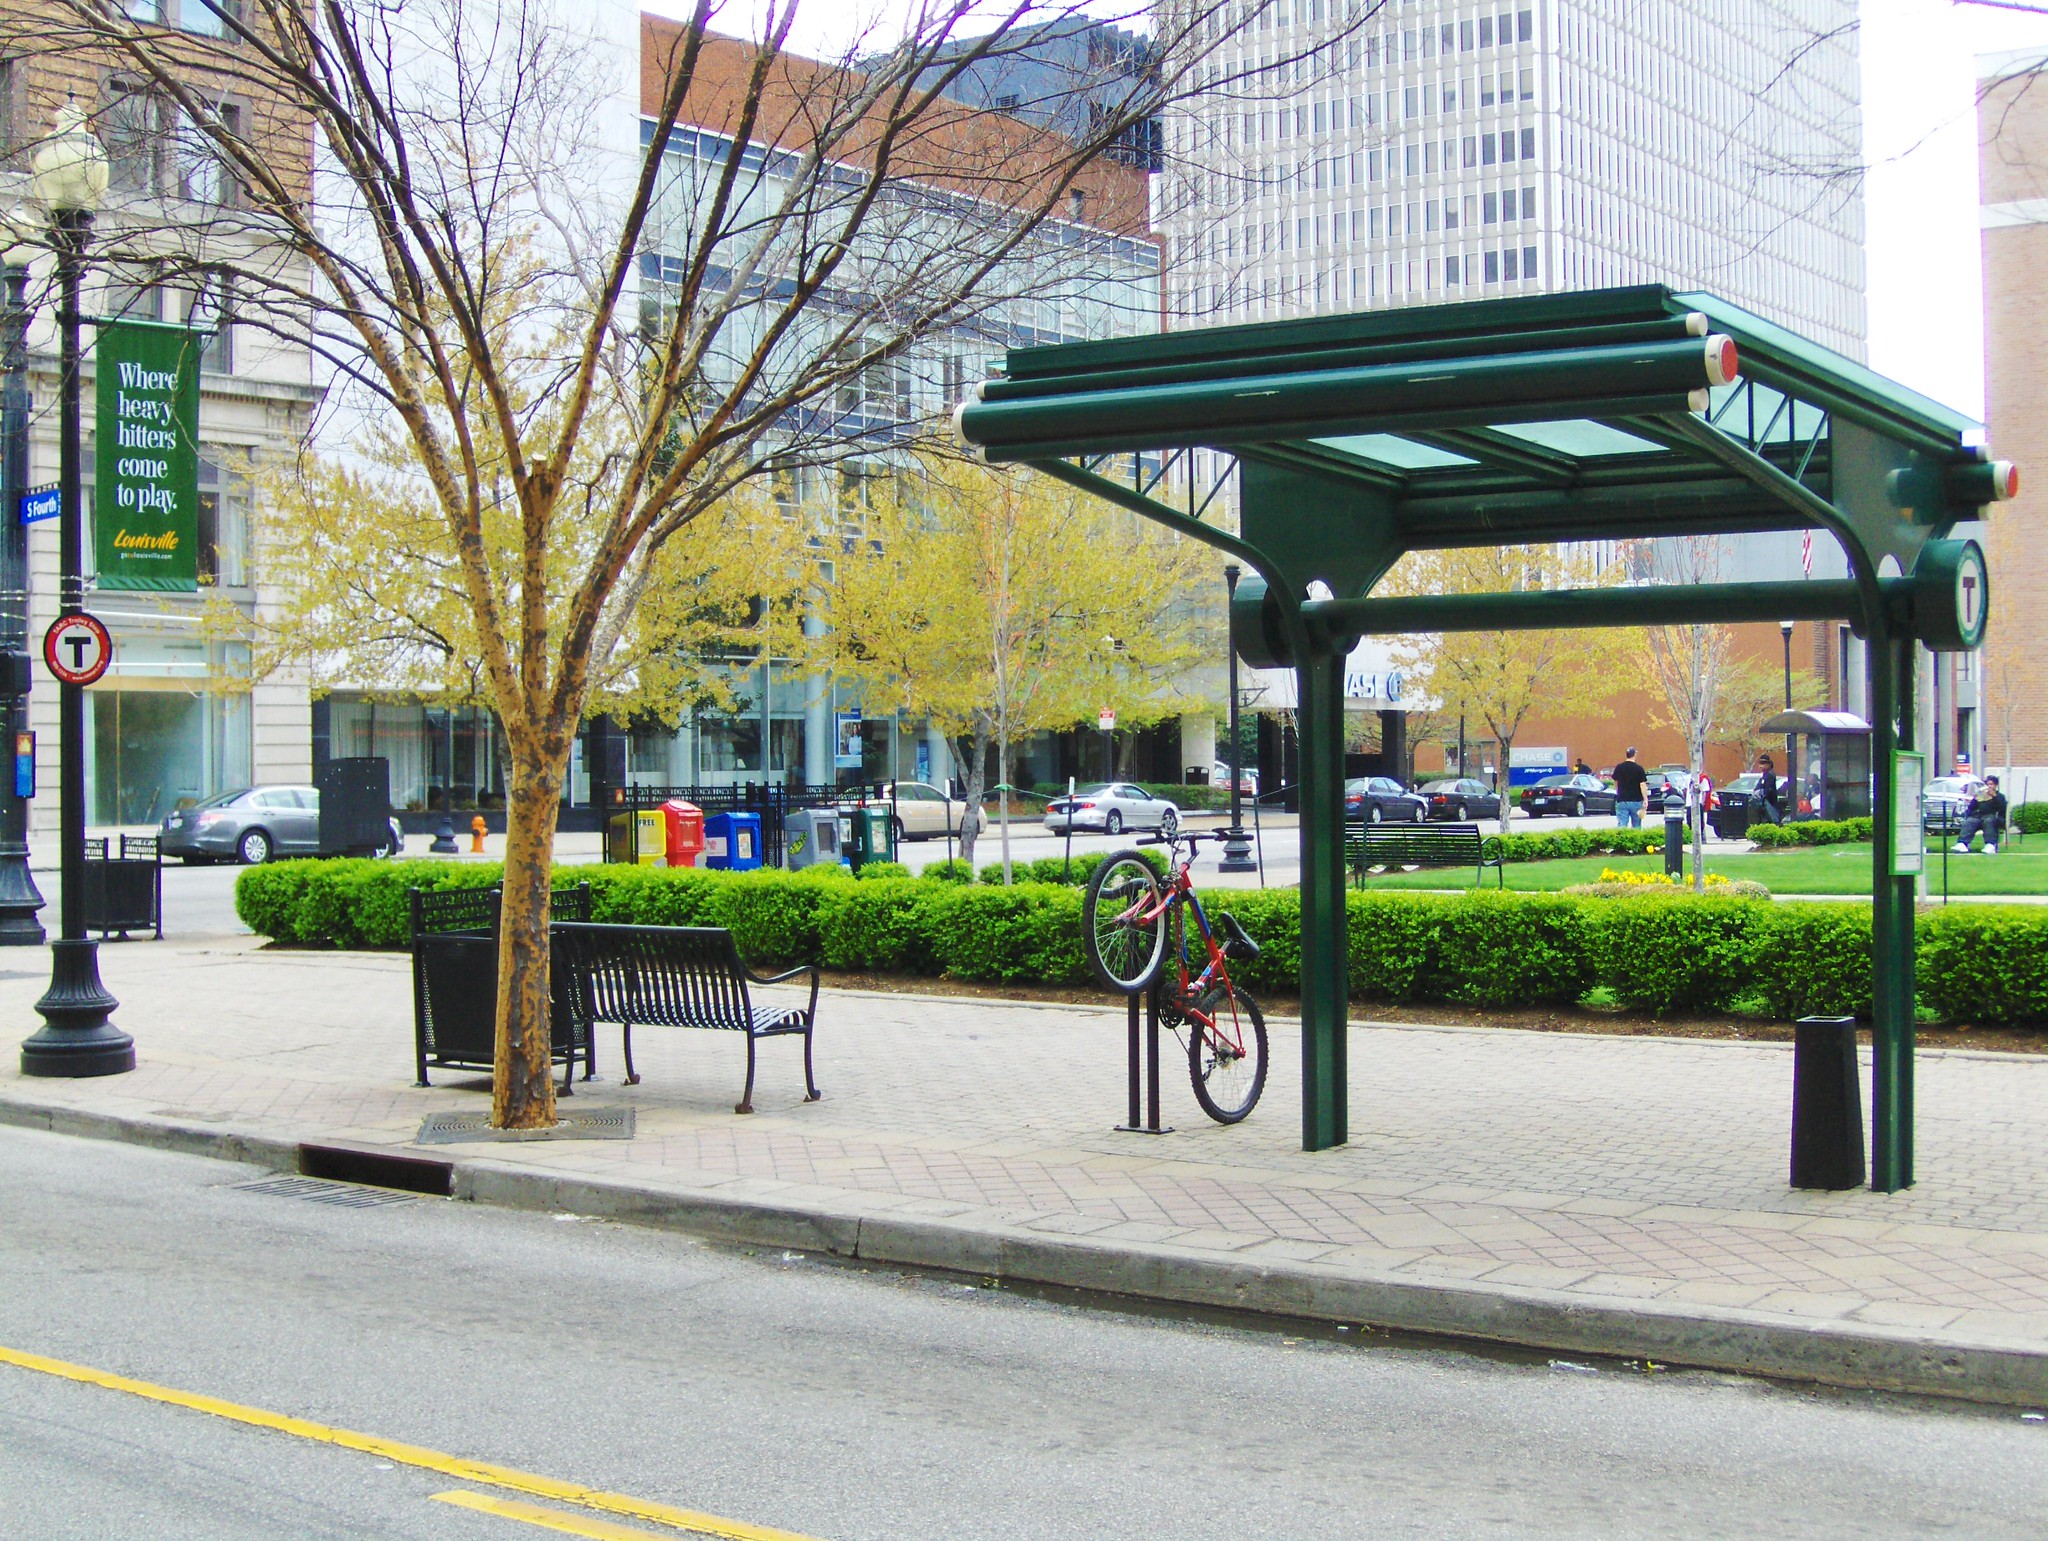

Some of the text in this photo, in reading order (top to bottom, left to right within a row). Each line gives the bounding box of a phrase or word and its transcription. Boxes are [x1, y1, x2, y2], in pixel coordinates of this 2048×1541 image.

[118, 362, 178, 391] Where
[118, 391, 173, 426] heavy
[118, 421, 176, 451] hitters
[118, 458, 168, 478] come
[27, 502, 33, 517] S
[33, 496, 57, 516] Fourth
[117, 482, 178, 514] to play.
[113, 529, 179, 549] Louisville
[1963, 576, 1976, 623] T
[65, 637, 91, 668] T
[1513, 753, 1552, 762] CHASE
[639, 818, 655, 827] FREE
